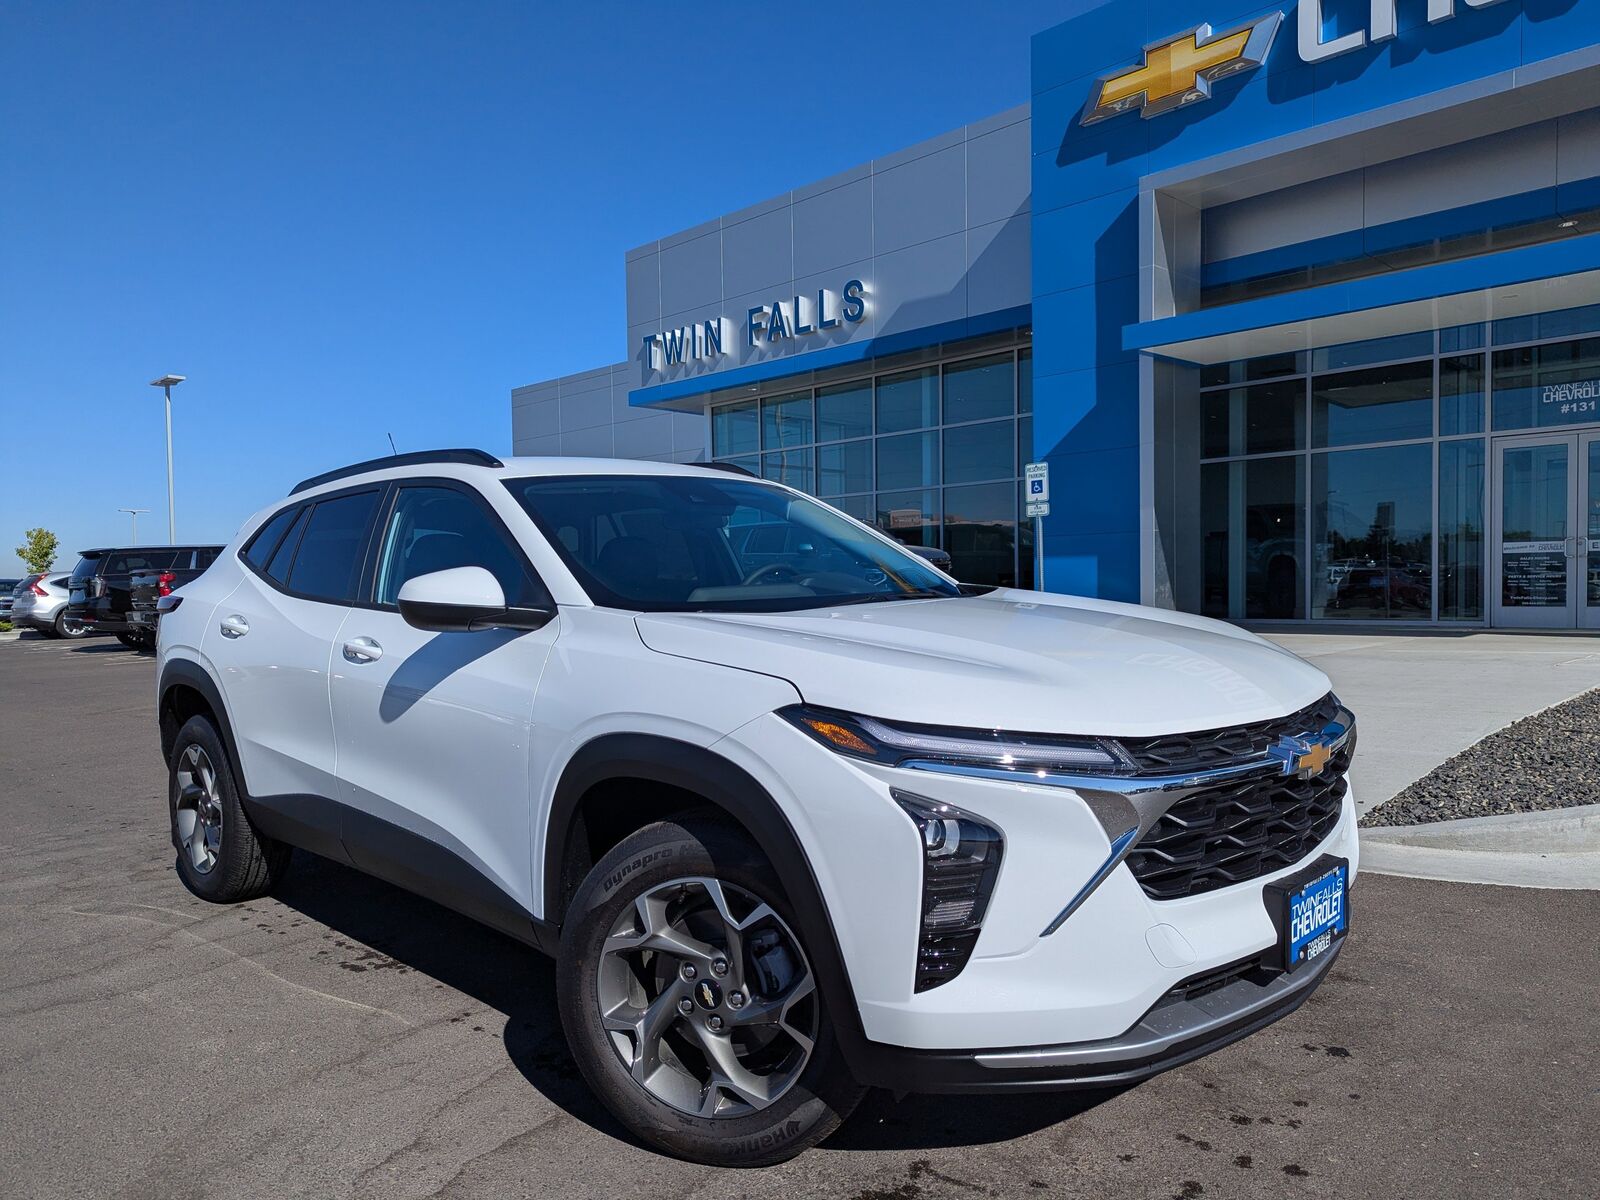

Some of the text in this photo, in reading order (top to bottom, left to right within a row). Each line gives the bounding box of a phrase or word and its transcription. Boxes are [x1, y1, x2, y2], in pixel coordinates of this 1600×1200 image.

[643, 279, 867, 370] TWIN FALLS
[1543, 380, 1600, 393] TWINFAL
[1543, 386, 1600, 403] CHEVROL
[1560, 400, 1596, 414] #131
[1292, 878, 1343, 920] TWINFALLS
[1291, 890, 1342, 944] CHEVROLET
[1307, 937, 1331, 961] CHEVROLET
